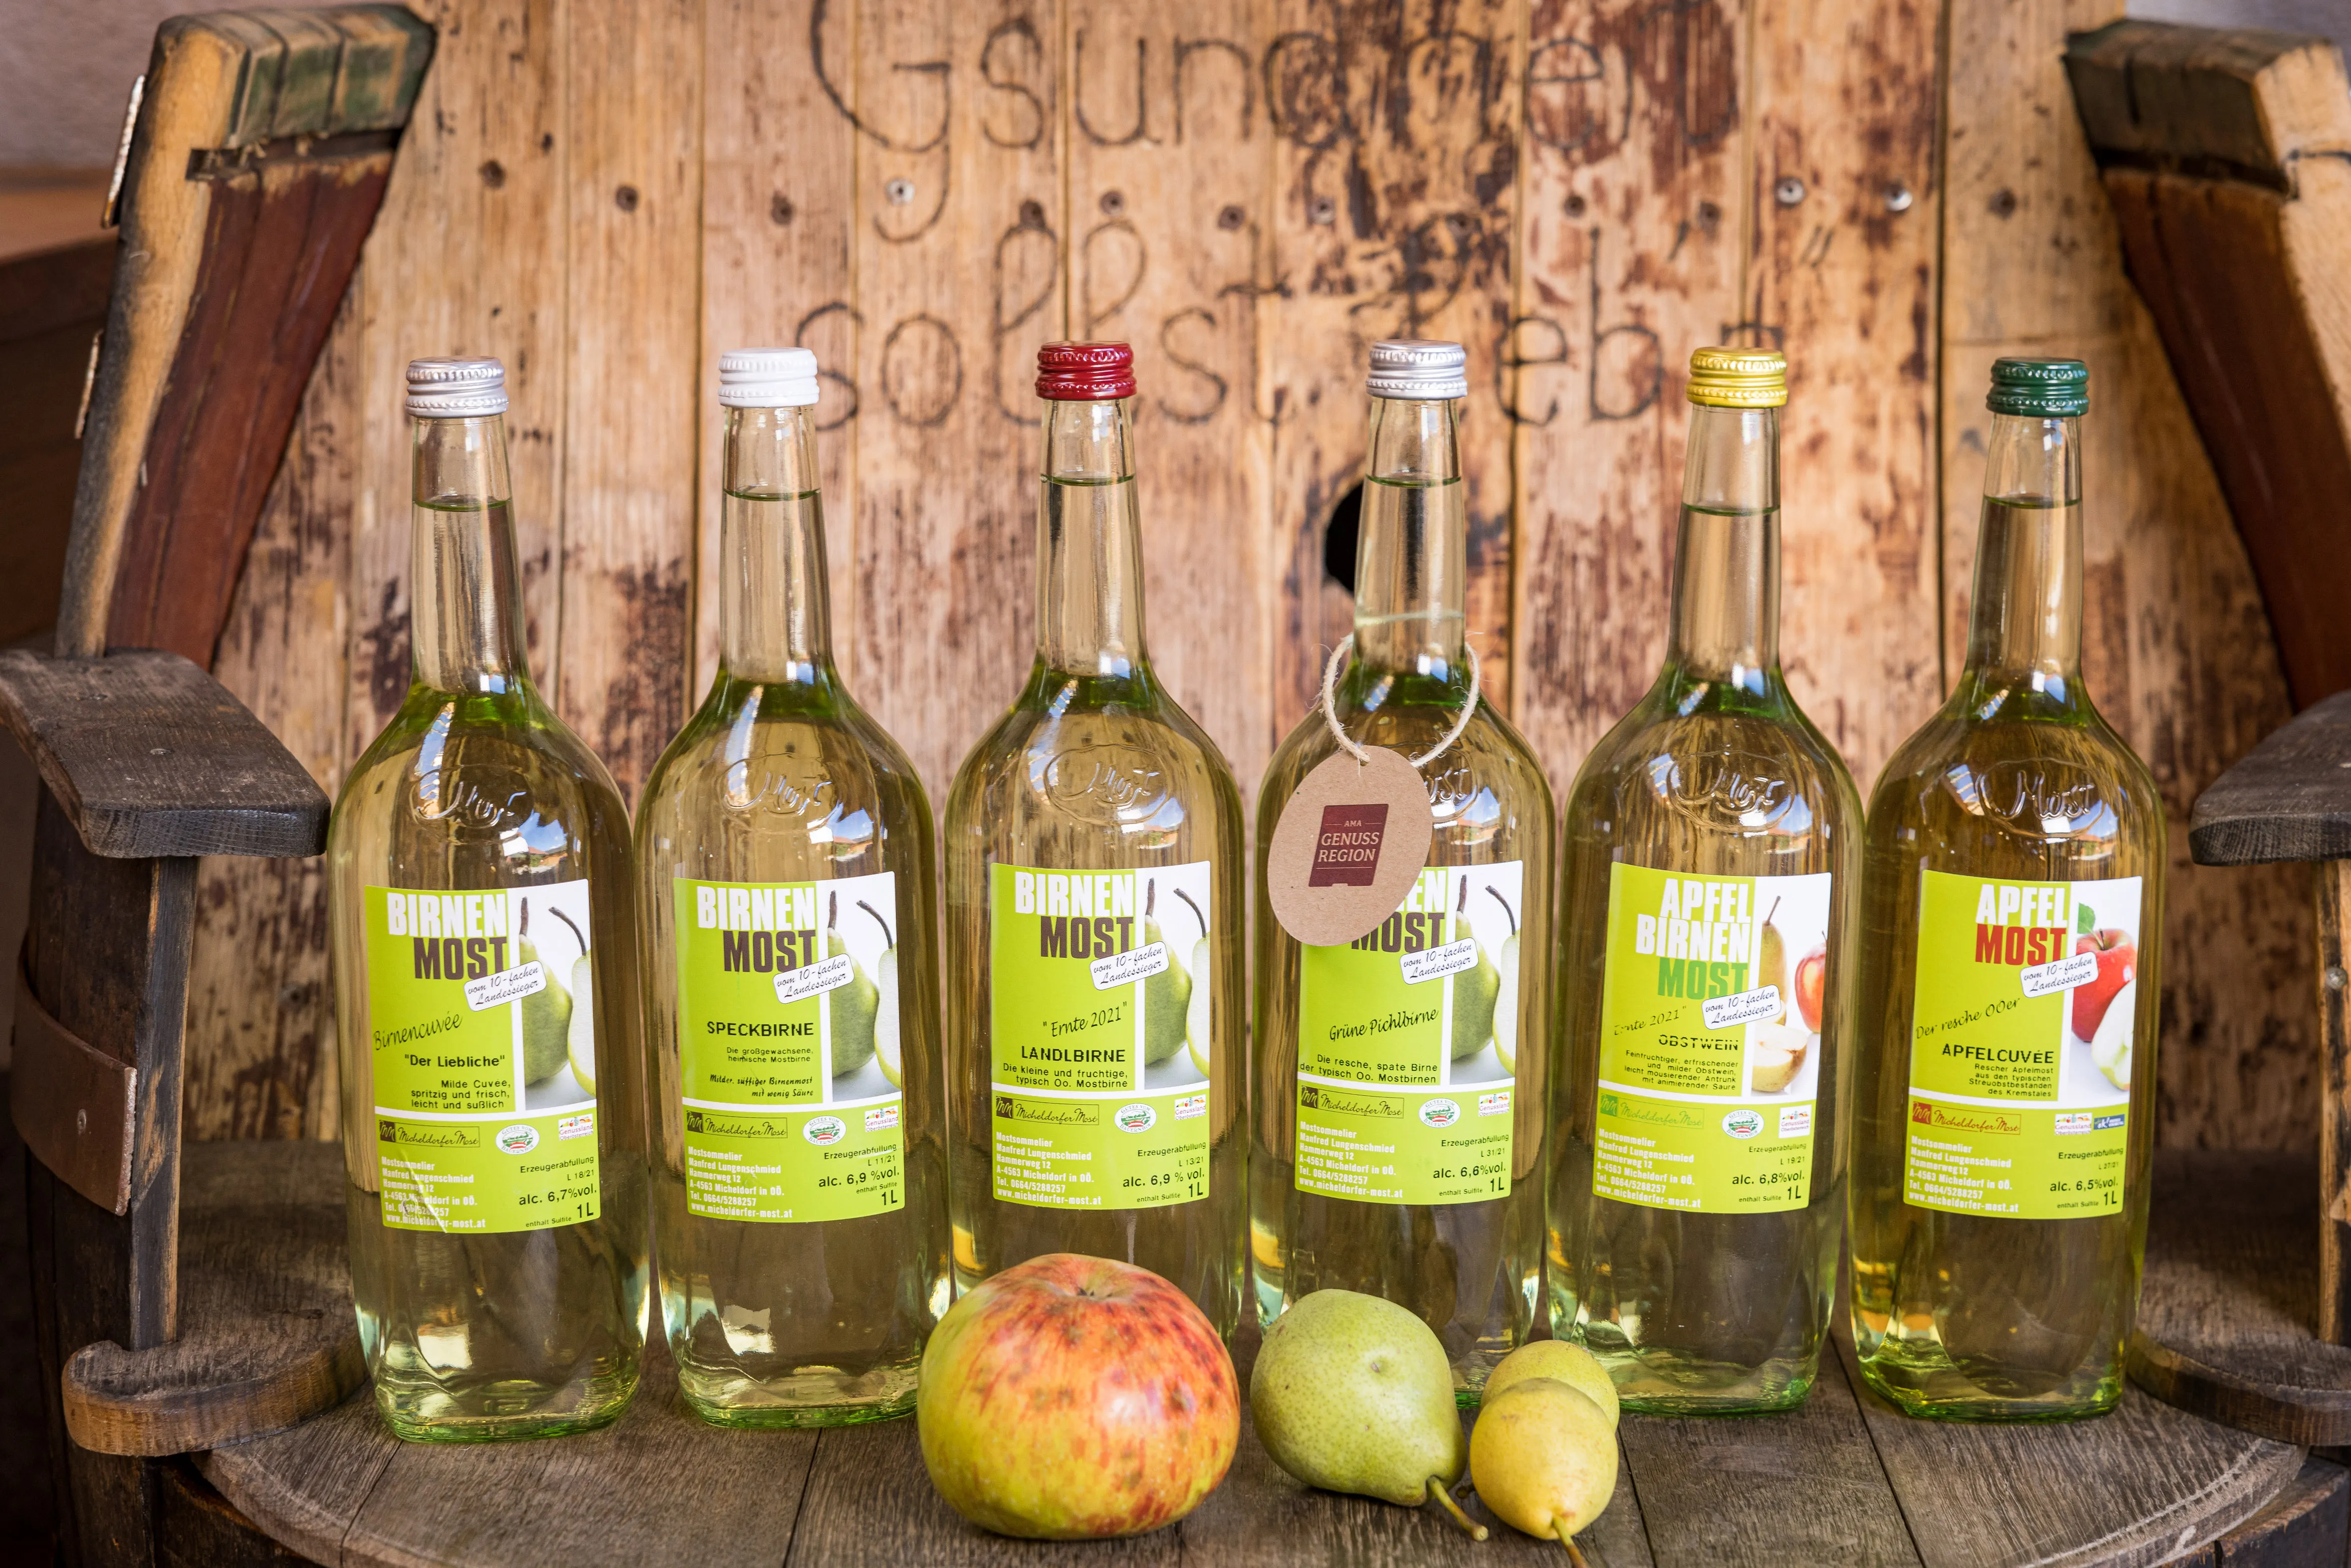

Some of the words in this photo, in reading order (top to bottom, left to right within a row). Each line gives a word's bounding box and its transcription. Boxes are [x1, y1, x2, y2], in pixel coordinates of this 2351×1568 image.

[1321, 832, 1380, 846] GENUSS
[1318, 849, 1376, 862] REGION
[1015, 871, 1133, 917] BIRNEN
[1659, 878, 1751, 923] APFEL
[697, 886, 816, 930] BIRNEN
[1976, 884, 2067, 927] APFEL
[387, 892, 507, 937] BIRNEN
[1041, 916, 1133, 959] MOST
[1635, 914, 1750, 963] BIRNEN
[1975, 924, 2066, 965] MOST
[414, 937, 507, 980] MOST
[723, 930, 816, 972] MOST
[1094, 963, 1111, 973] vom
[1403, 957, 1421, 967] vom
[1409, 957, 1471, 979] Landessieger
[1100, 960, 1162, 984] Landessieger
[1657, 957, 1748, 1000] MOST
[2024, 970, 2041, 980] vom
[468, 984, 486, 994] vom
[777, 977, 795, 987] vom
[784, 973, 846, 998] Landessieger
[2030, 971, 2091, 992] Landessieger
[476, 980, 538, 1005] Landessieger
[1706, 1002, 1723, 1013] vom
[1711, 1003, 1773, 1024] Landessieger
[374, 1011, 462, 1050] Birnencuvée
[707, 1021, 814, 1036] SPECKBIRNE
[1330, 1023, 1368, 1042] Grüne
[1370, 1009, 1439, 1036] Pichlbirne
[1916, 1024, 1938, 1039] Der
[1941, 1012, 1982, 1031] resche
[1659, 1035, 1738, 1050] OBSTWEIN
[405, 1054, 431, 1066] "Der
[438, 1055, 505, 1067] Liebliche"
[1021, 1045, 1125, 1062] LANDLBIRNE
[1942, 1043, 2054, 1063] APFELCUVÉE
[1317, 1054, 1330, 1063] Die
[1335, 1058, 1371, 1070] resche,
[1975, 1063, 2008, 1072] Rescher
[1003, 1063, 1017, 1072] Die
[1021, 1065, 1049, 1076] kleine
[1077, 1070, 1128, 1079] fruchtige,
[1300, 1062, 1314, 1071] der
[1319, 1066, 1352, 1078] typisch
[1379, 1074, 1436, 1083] Mostbirnen
[1647, 1070, 1700, 1081] mousierender
[1696, 1067, 1736, 1076] Obstwein,
[1016, 1076, 1049, 1086] typisch
[412, 1090, 447, 1100] spritzig
[477, 1089, 510, 1098] frisch,
[767, 1090, 789, 1098] wenig
[412, 1100, 437, 1108] leicht
[1321, 1094, 1385, 1116] Micheldorfer
[1380, 1101, 1403, 1116] Most
[1015, 1104, 1079, 1124] Micheldorfer
[1074, 1109, 1097, 1122] Most
[1933, 1110, 2001, 1133] Micheldorfer
[1996, 1117, 2019, 1132] Most
[706, 1118, 767, 1138] Micheldorfer
[762, 1122, 786, 1136] Most
[1300, 1121, 1357, 1139] Mostsommelier
[398, 1127, 461, 1147] Micheldorfer
[454, 1131, 479, 1145] Most
[996, 1132, 1053, 1148] Mostsommelier
[1300, 1133, 1329, 1147] Manfred
[1331, 1139, 1394, 1153] Lungenschmied
[688, 1147, 743, 1161] Mostsommelier
[996, 1143, 1025, 1156] Manfred
[1027, 1149, 1091, 1160] Lungenschmied
[689, 1157, 716, 1171] Manfred
[718, 1162, 781, 1174] Lungenschmied
[996, 1153, 1040, 1169] Hammerweg
[689, 1168, 731, 1182] Hammerweg
[819, 1176, 841, 1187] alc.
[847, 1172, 866, 1184] 6,9
[997, 1165, 1021, 1177] A-4563
[1023, 1170, 1066, 1181] Micheldorf
[1080, 1172, 1094, 1182] OÖ.
[1123, 1176, 1145, 1187] alc.
[1151, 1173, 1170, 1185] 6,9
[1187, 1167, 1204, 1180] vol.
[1433, 1168, 1455, 1179] alc.
[1732, 1175, 1754, 1185] alc.
[690, 1179, 712, 1191] A-4563
[715, 1183, 757, 1194] Micheldorf
[770, 1186, 784, 1196] OÖ.
[997, 1177, 1009, 1187] Tel.
[1011, 1180, 1066, 1193] 0664/5288257
[2050, 1181, 2070, 1191] alc.
[519, 1194, 542, 1205] alc.
[691, 1191, 702, 1201] Tel.
[704, 1193, 756, 1206] 0664/5288257
[997, 1188, 1101, 1205] www.micheldorfer-most.at
[691, 1203, 792, 1218] www.micheldorfer-most.at
